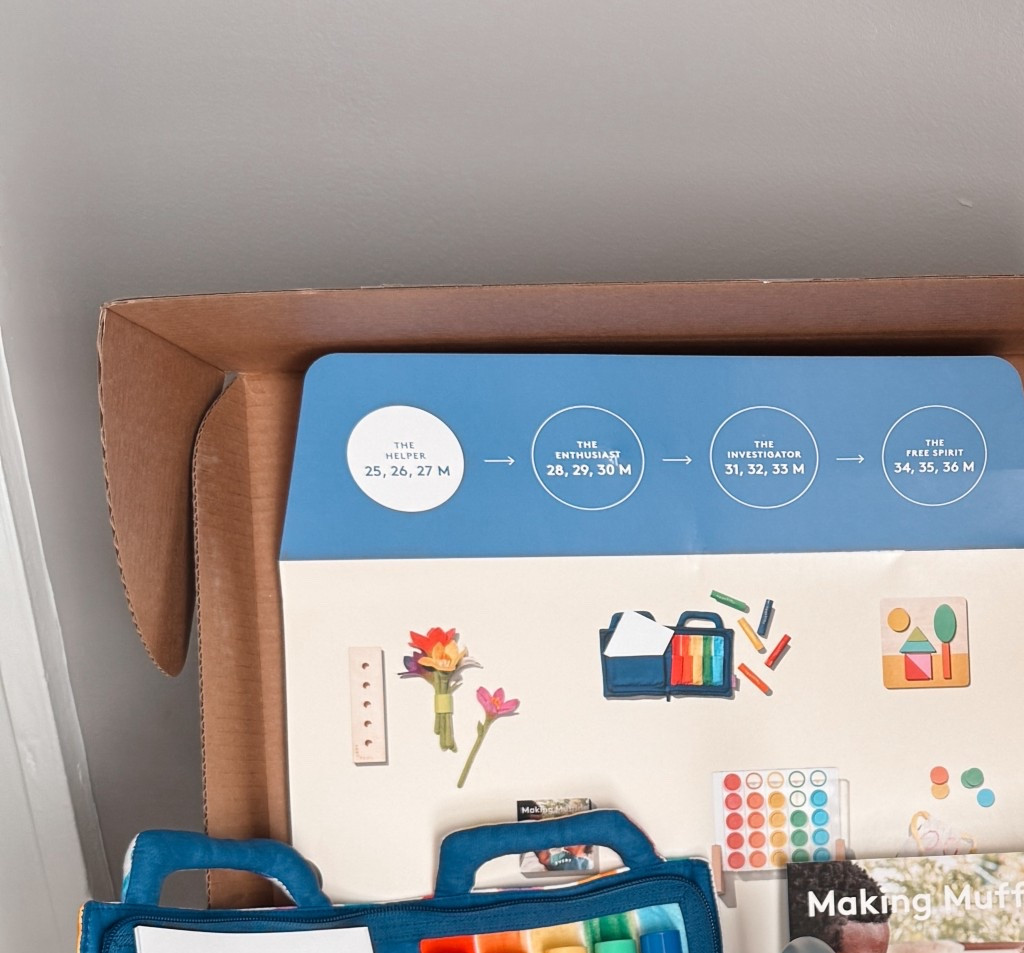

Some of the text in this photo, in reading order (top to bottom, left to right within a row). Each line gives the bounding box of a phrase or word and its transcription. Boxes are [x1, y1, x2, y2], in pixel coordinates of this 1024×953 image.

[577, 440, 597, 448] THE
[385, 452, 426, 460] HELPER
[555, 450, 621, 459] ENTHUSIAST
[727, 450, 802, 458] INVESTIGATOR
[906, 448, 964, 457] FREE SPIRIT
[365, 465, 450, 478] 25, 26, 27 M
[546, 464, 632, 477] 28, 29, 30 M
[725, 463, 805, 475] 31, 32, 33 M
[894, 461, 975, 474] 34, 35, 36 M
[808, 888, 932, 921] Making
